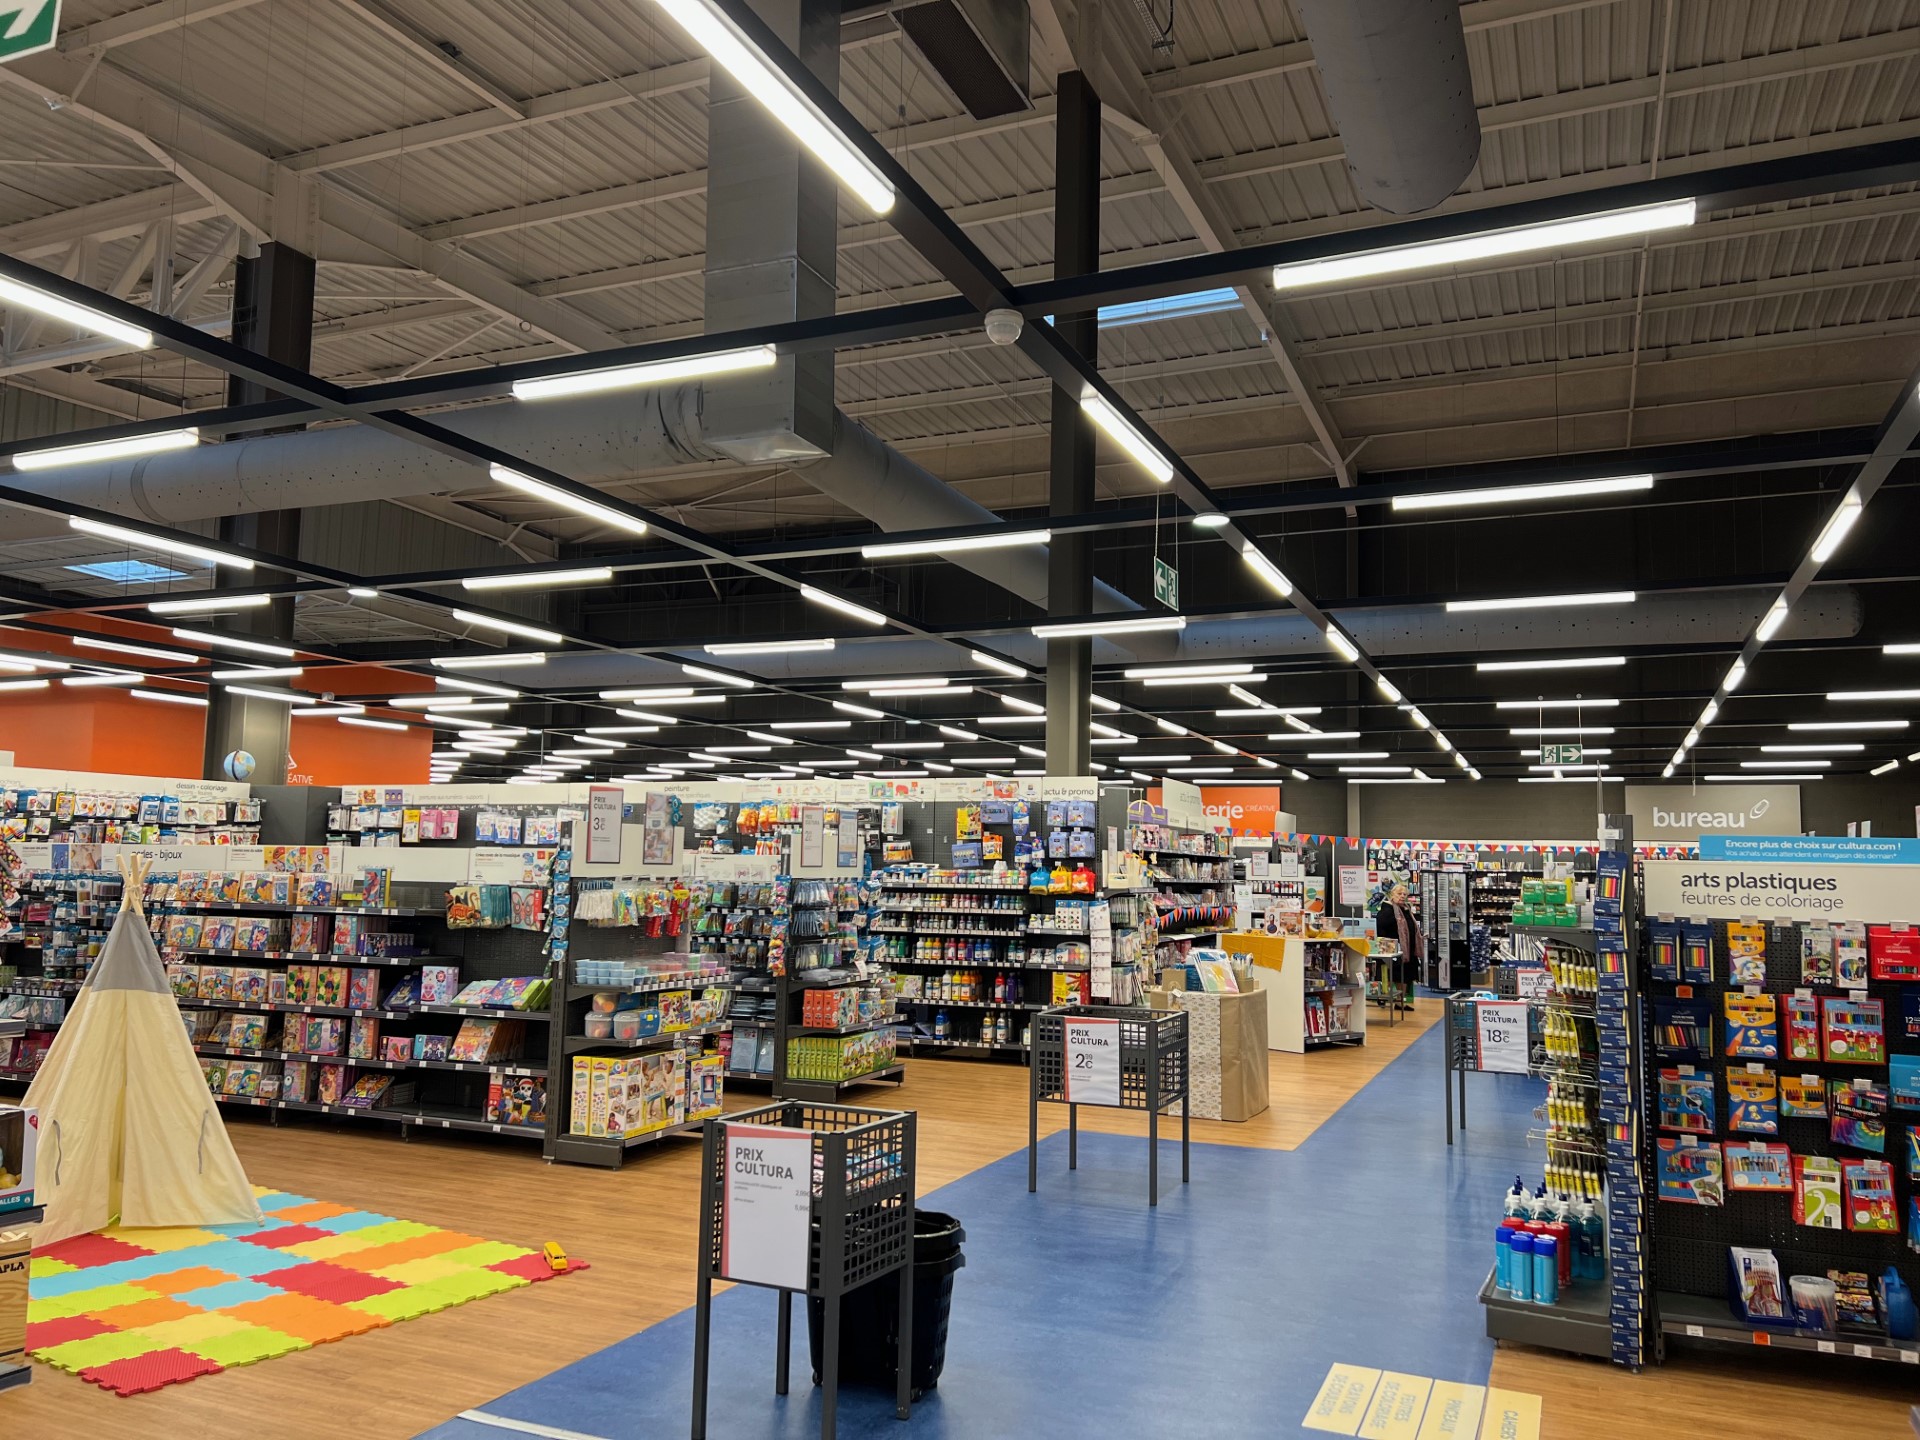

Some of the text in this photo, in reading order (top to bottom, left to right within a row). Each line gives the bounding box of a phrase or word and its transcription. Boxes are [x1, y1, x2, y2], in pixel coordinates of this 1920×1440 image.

[288, 771, 314, 785] ÉATIVE
[200, 784, 228, 792] coloriage
[1044, 787, 1095, 797] actu & promo
[1201, 801, 1276, 819] terie CRÉATIVE
[593, 817, 600, 831] 3
[1652, 806, 1745, 829] bureau
[1725, 840, 1758, 848] Encore
[1760, 841, 1779, 850] plus
[1780, 840, 1793, 848] de
[1794, 841, 1820, 849] choix
[1838, 842, 1896, 851] cultura.com
[160, 850, 183, 861] bijoux
[1823, 852, 1852, 860] magasin
[1681, 872, 1837, 893] arts plastiques
[1681, 891, 1844, 912] feutres de coloriage
[1482, 1016, 1518, 1024] CULTURA
[1070, 1028, 1090, 1037] PRIX
[1486, 1029, 1502, 1043] 18
[1070, 1037, 1109, 1047] CULTURA
[1075, 1053, 1085, 1069] 2
[735, 1147, 764, 1162] PRIX
[735, 1161, 794, 1180] CULTURA
[1500, 1409, 1519, 1440] CAHIERS
